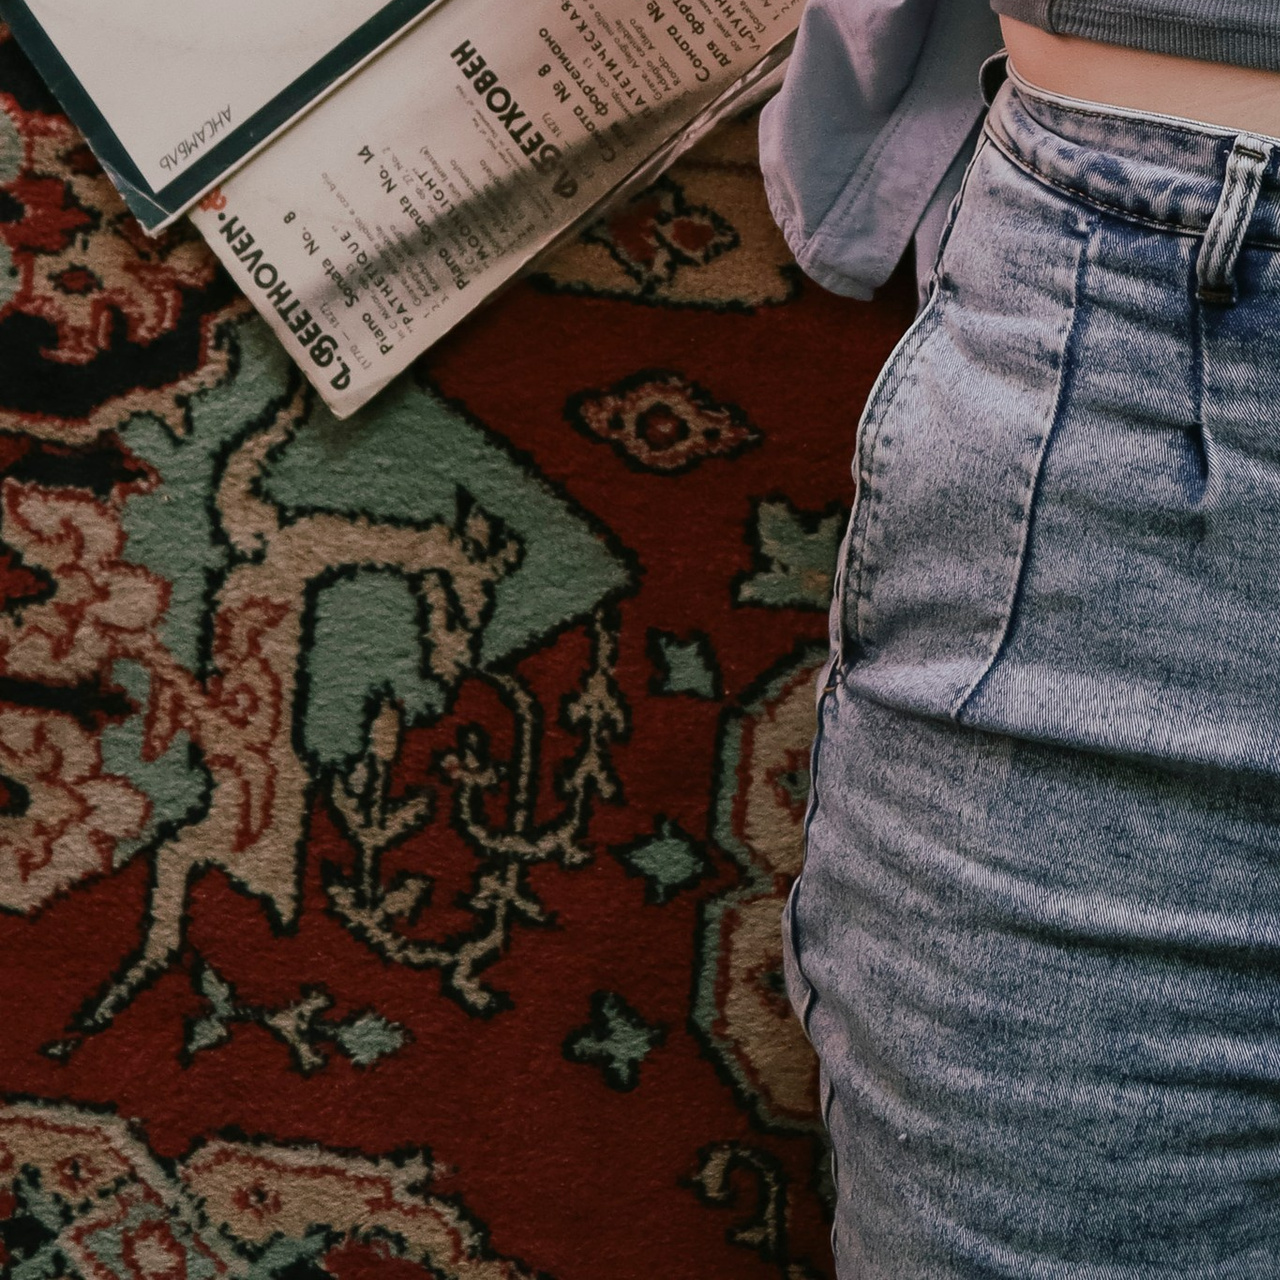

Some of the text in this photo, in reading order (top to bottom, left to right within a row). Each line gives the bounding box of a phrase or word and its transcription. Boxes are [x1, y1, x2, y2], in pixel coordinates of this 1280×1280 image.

[593, 10, 614, 36] molto
[645, 0, 665, 23] №
[739, 0, 766, 33] (Sonata
[614, 18, 645, 57] cantabile
[629, 17, 655, 50] Allegro
[582, 56, 593, 69] 13
[613, 37, 640, 69] Allegro
[657, 52, 681, 86] Rondo.
[666, 24, 710, 82] Соната
[705, 39, 732, 67] для
[537, 63, 551, 77] 8
[538, 27, 608, 116] фортепиано
[645, 59, 671, 91] Adagio
[552, 79, 571, 103] №
[159, 103, 233, 171] АНСАМБЛЬ
[356, 144, 470, 290] Piano Sonata No. 14
[282, 210, 394, 355] Piano Sonata No. 8
